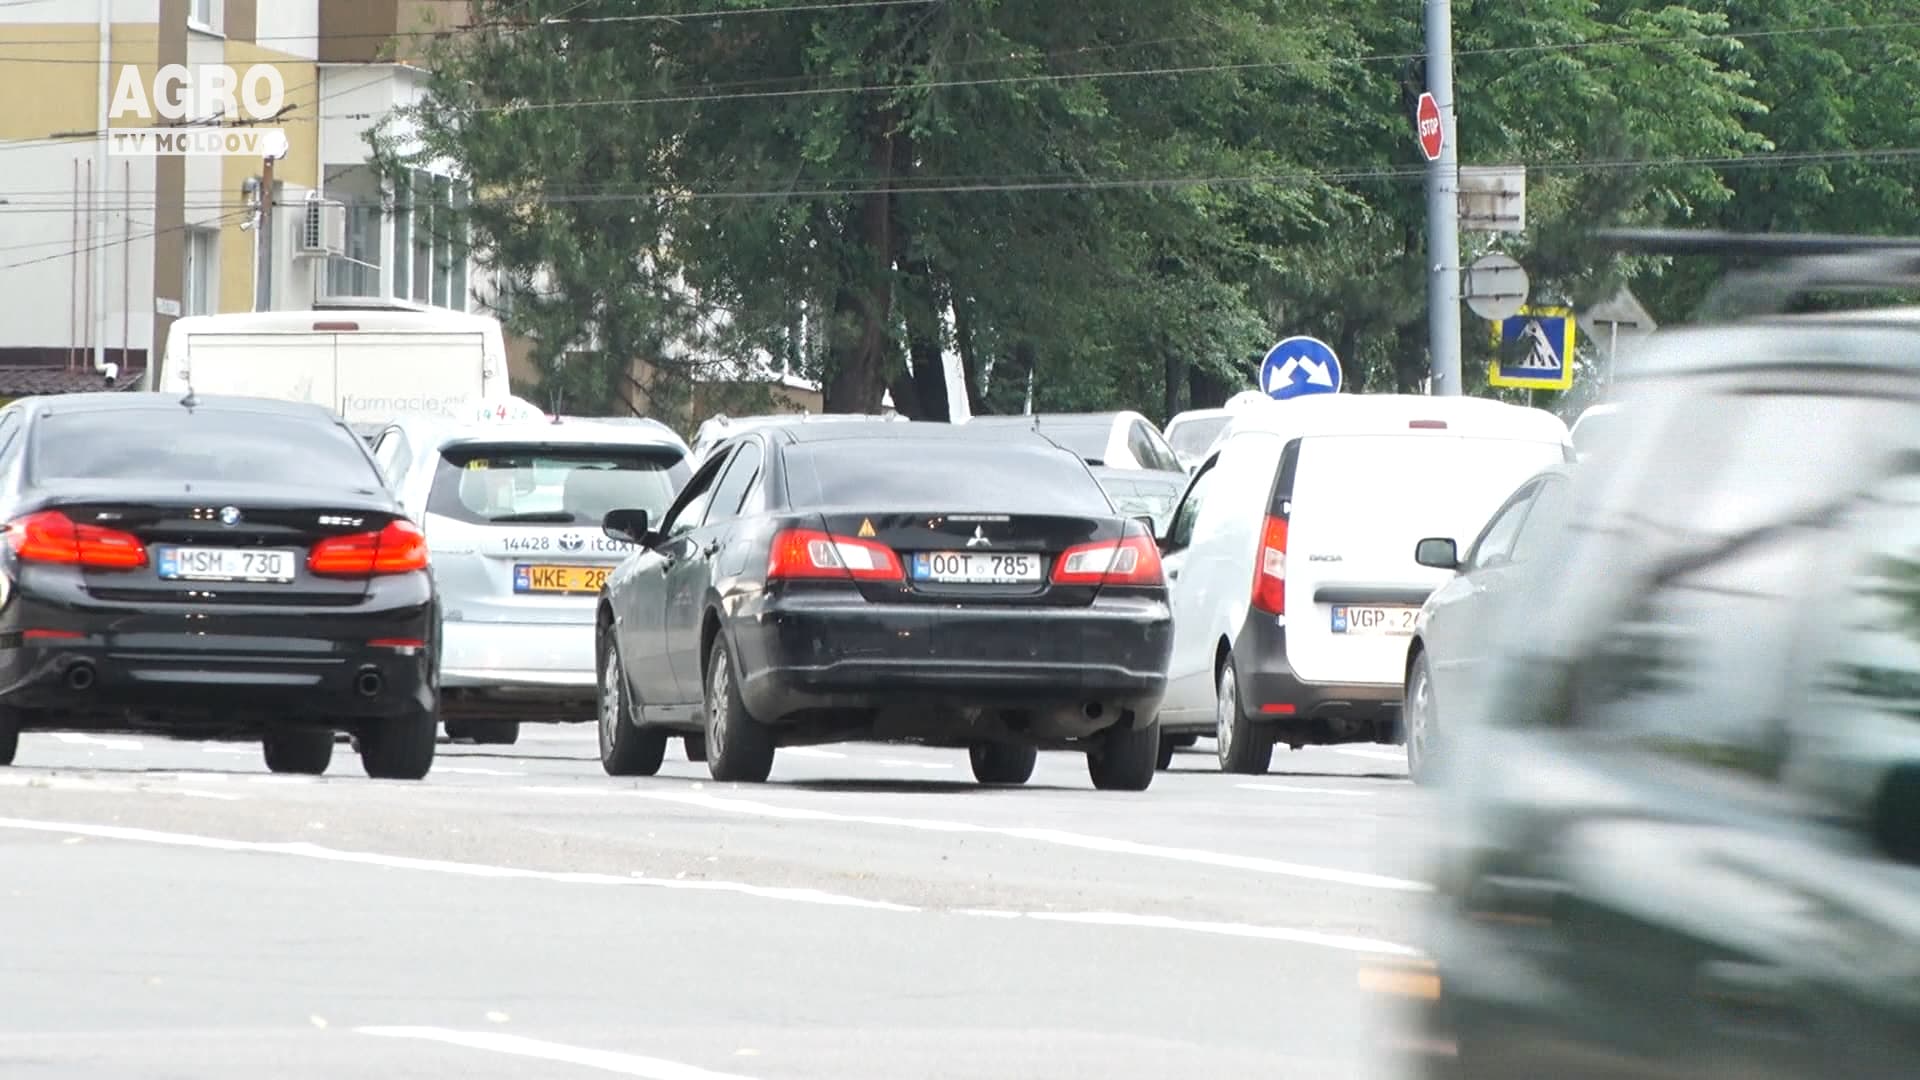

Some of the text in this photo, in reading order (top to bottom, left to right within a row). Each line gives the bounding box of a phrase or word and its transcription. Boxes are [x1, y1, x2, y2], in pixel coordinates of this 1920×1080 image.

[1421, 116, 1438, 137] STOP
[503, 536, 550, 551] 14428
[181, 551, 222, 572] MSM
[242, 553, 281, 574] 730
[991, 556, 1029, 576] 785
[532, 569, 568, 588] WKE
[584, 570, 611, 588] 28
[1350, 609, 1385, 628] VGP
